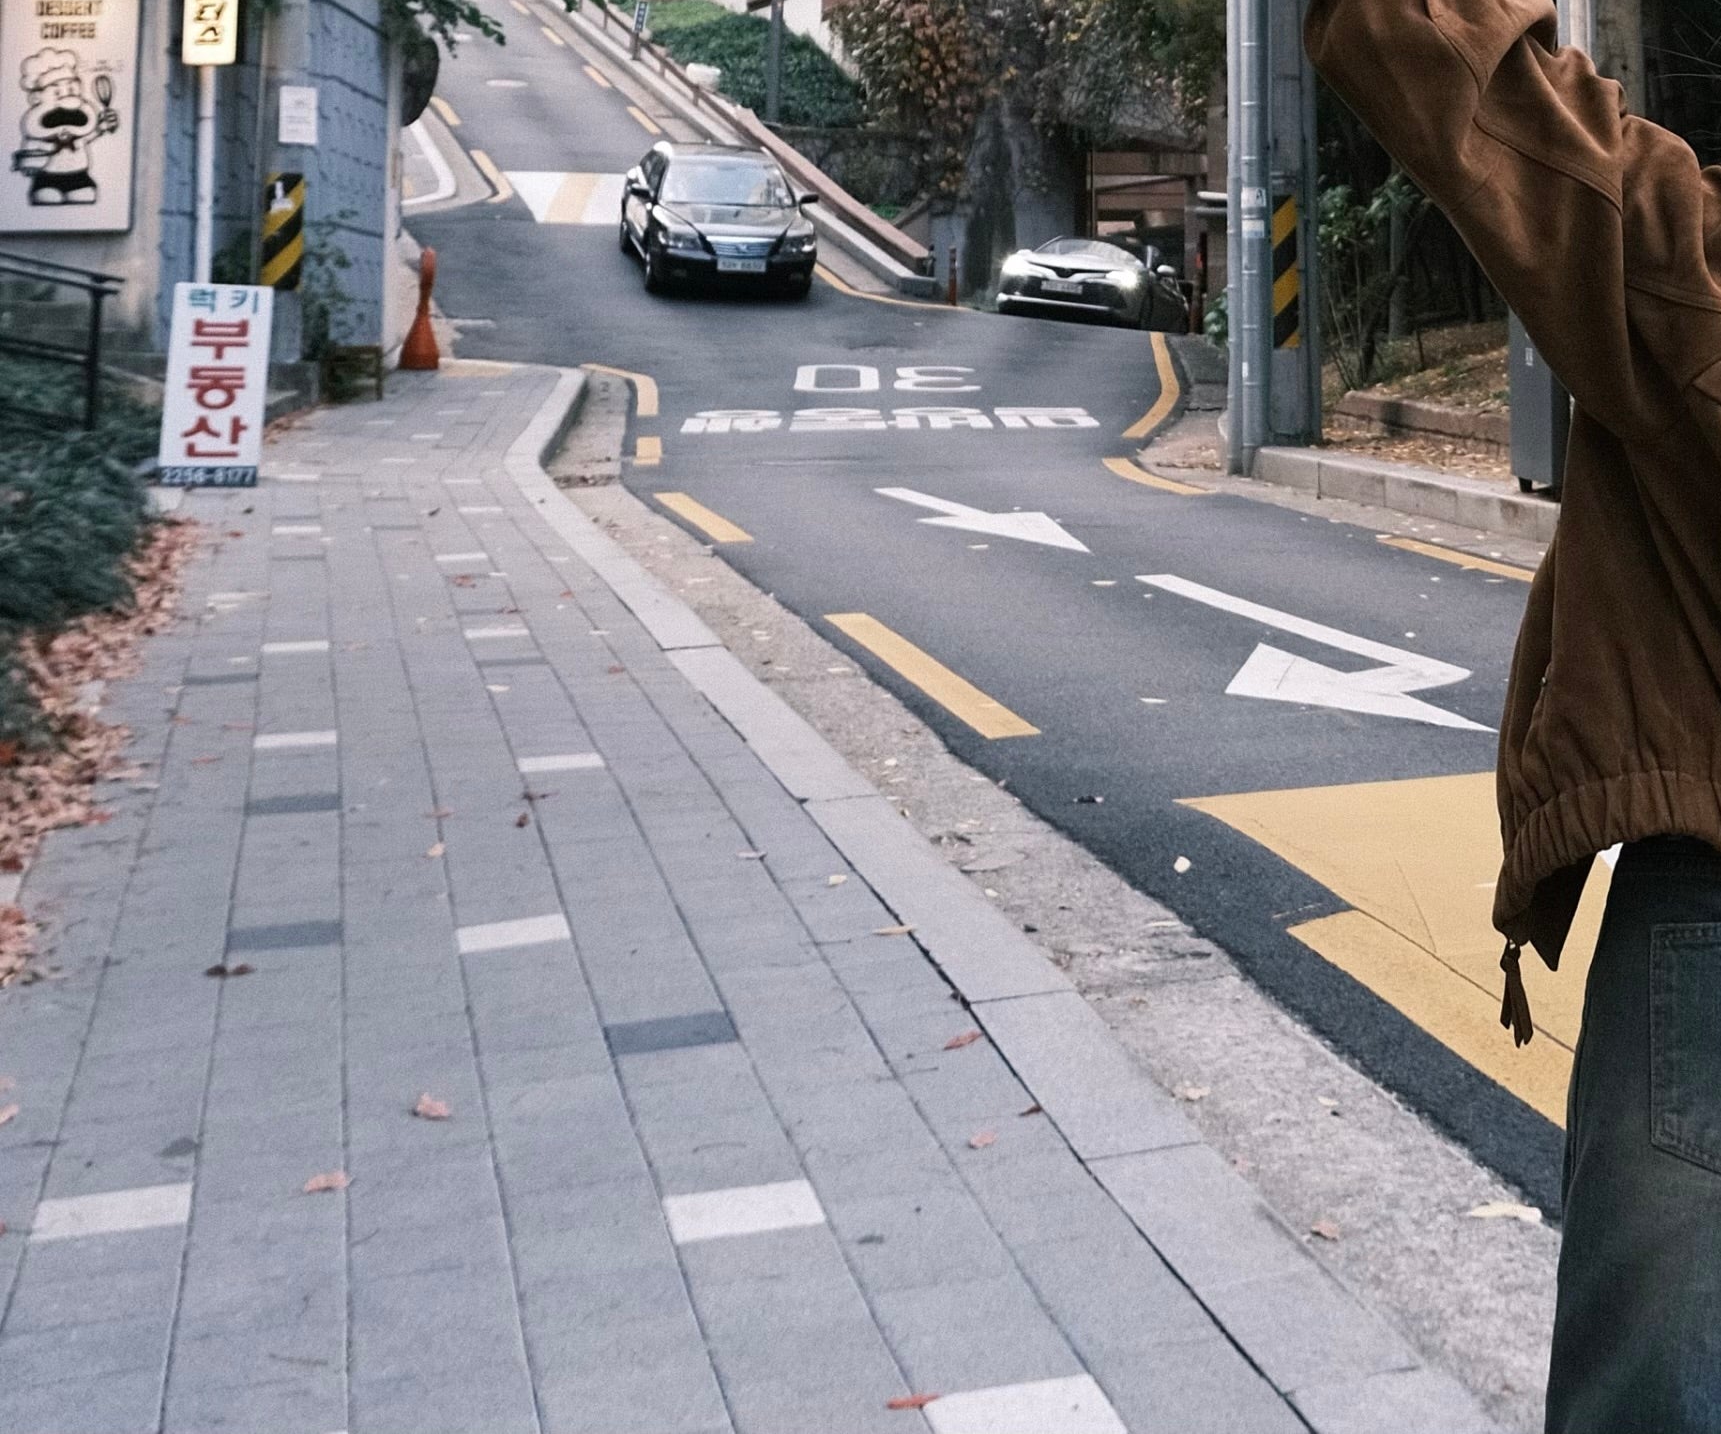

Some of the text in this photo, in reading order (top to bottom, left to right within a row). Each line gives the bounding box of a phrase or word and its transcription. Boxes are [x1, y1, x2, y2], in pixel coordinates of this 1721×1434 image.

[41, 22, 97, 39] COFFEE
[181, 318, 250, 458] 부동산
[793, 364, 982, 393] 30
